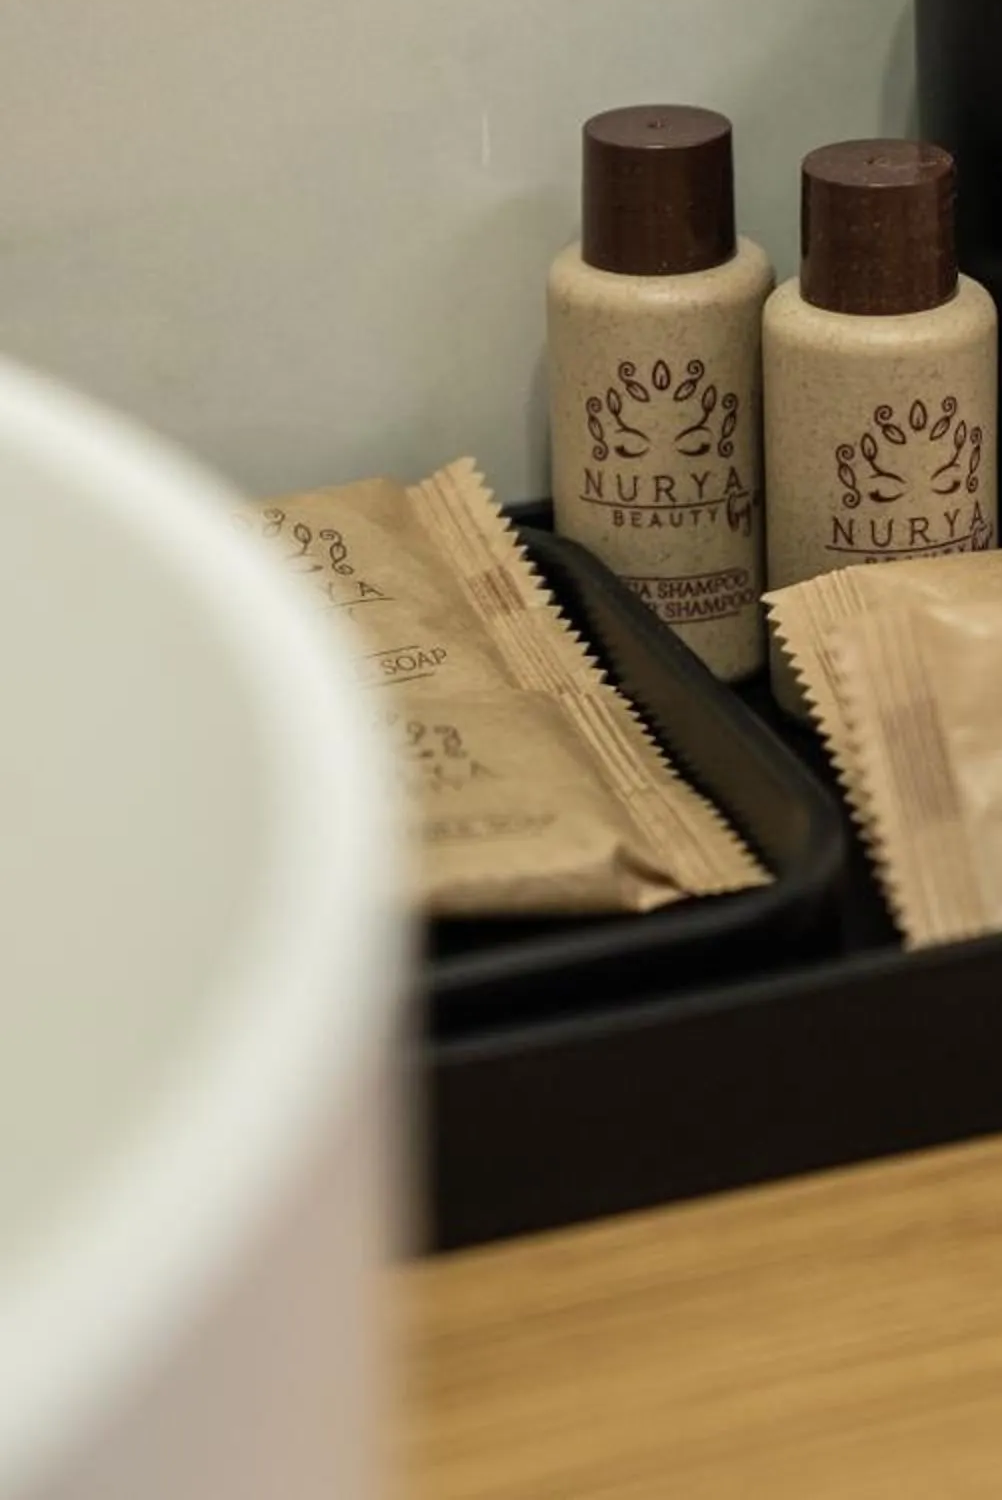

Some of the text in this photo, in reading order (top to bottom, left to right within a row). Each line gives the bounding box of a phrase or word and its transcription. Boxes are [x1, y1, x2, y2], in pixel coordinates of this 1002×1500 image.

[583, 465, 744, 502] NURYA
[611, 508, 719, 529] BEAUTY
[832, 500, 986, 547] NURYA
[657, 570, 749, 599] SHAMPOO
[665, 588, 757, 618] SHAMPOO
[380, 647, 448, 676] SOAP
